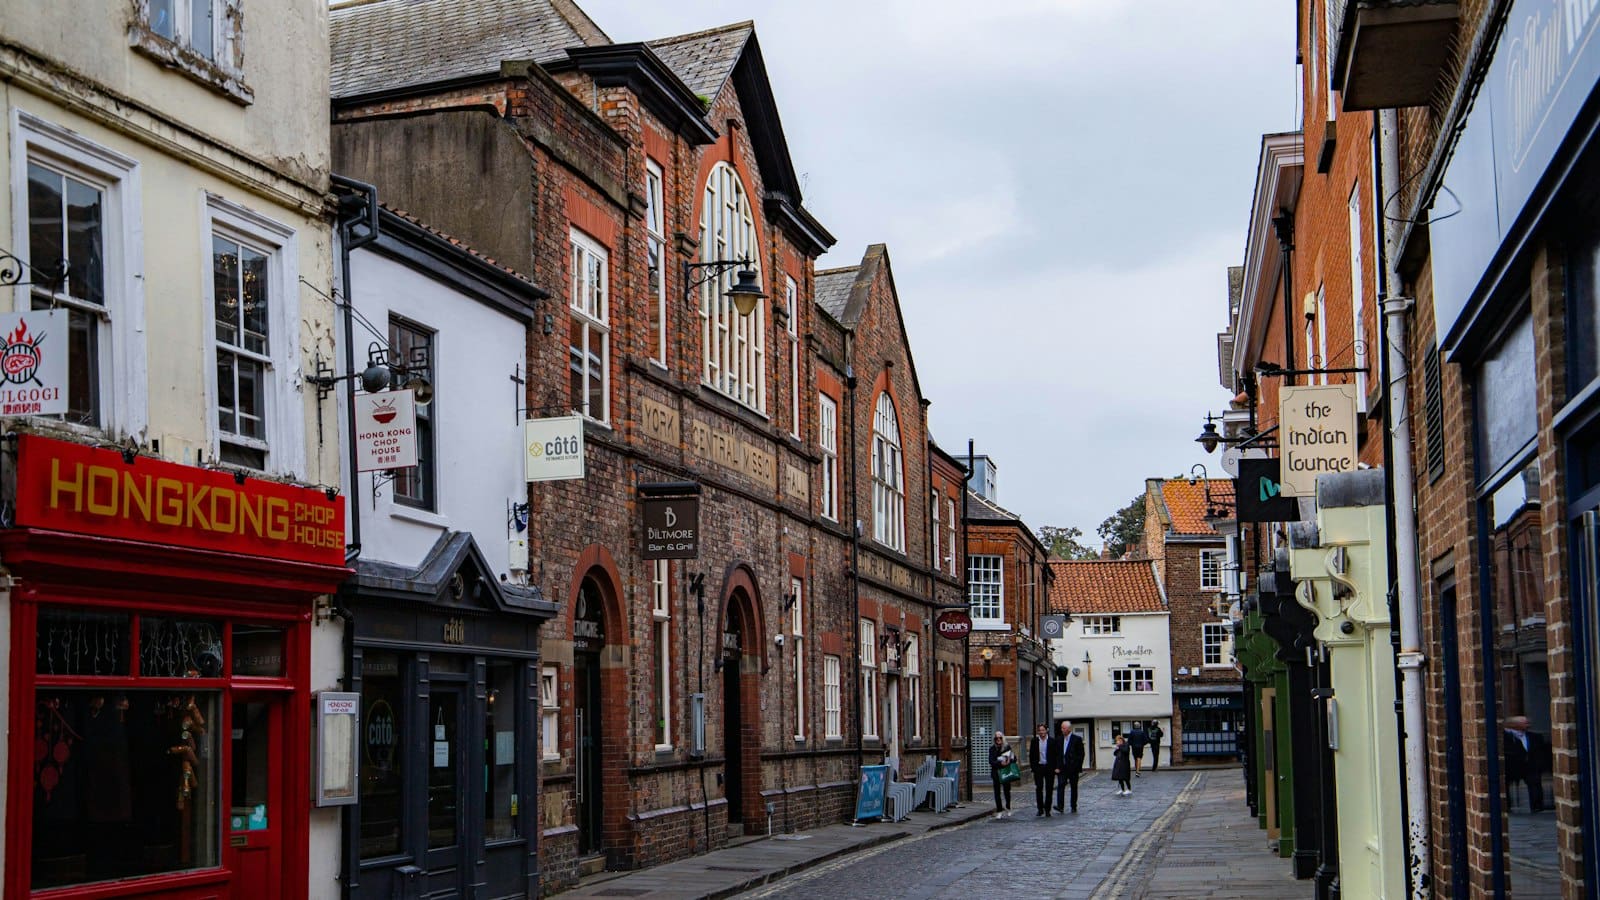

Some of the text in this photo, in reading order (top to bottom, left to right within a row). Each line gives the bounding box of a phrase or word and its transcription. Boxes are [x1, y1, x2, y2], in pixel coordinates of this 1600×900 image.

[1305, 400, 1331, 419] the
[644, 404, 676, 440] YORK
[359, 428, 411, 440] HONG KONG
[373, 438, 398, 446] CHOP
[545, 435, 578, 455] côtô
[1289, 424, 1348, 446] indian
[371, 446, 401, 455] HOUSE
[1288, 451, 1350, 473] lounge
[50, 458, 289, 541] HONGKONG
[294, 502, 335, 525] CHOP
[294, 524, 344, 550] HOUSE
[648, 527, 693, 540] BILTMORE
[369, 715, 392, 745] côtô
